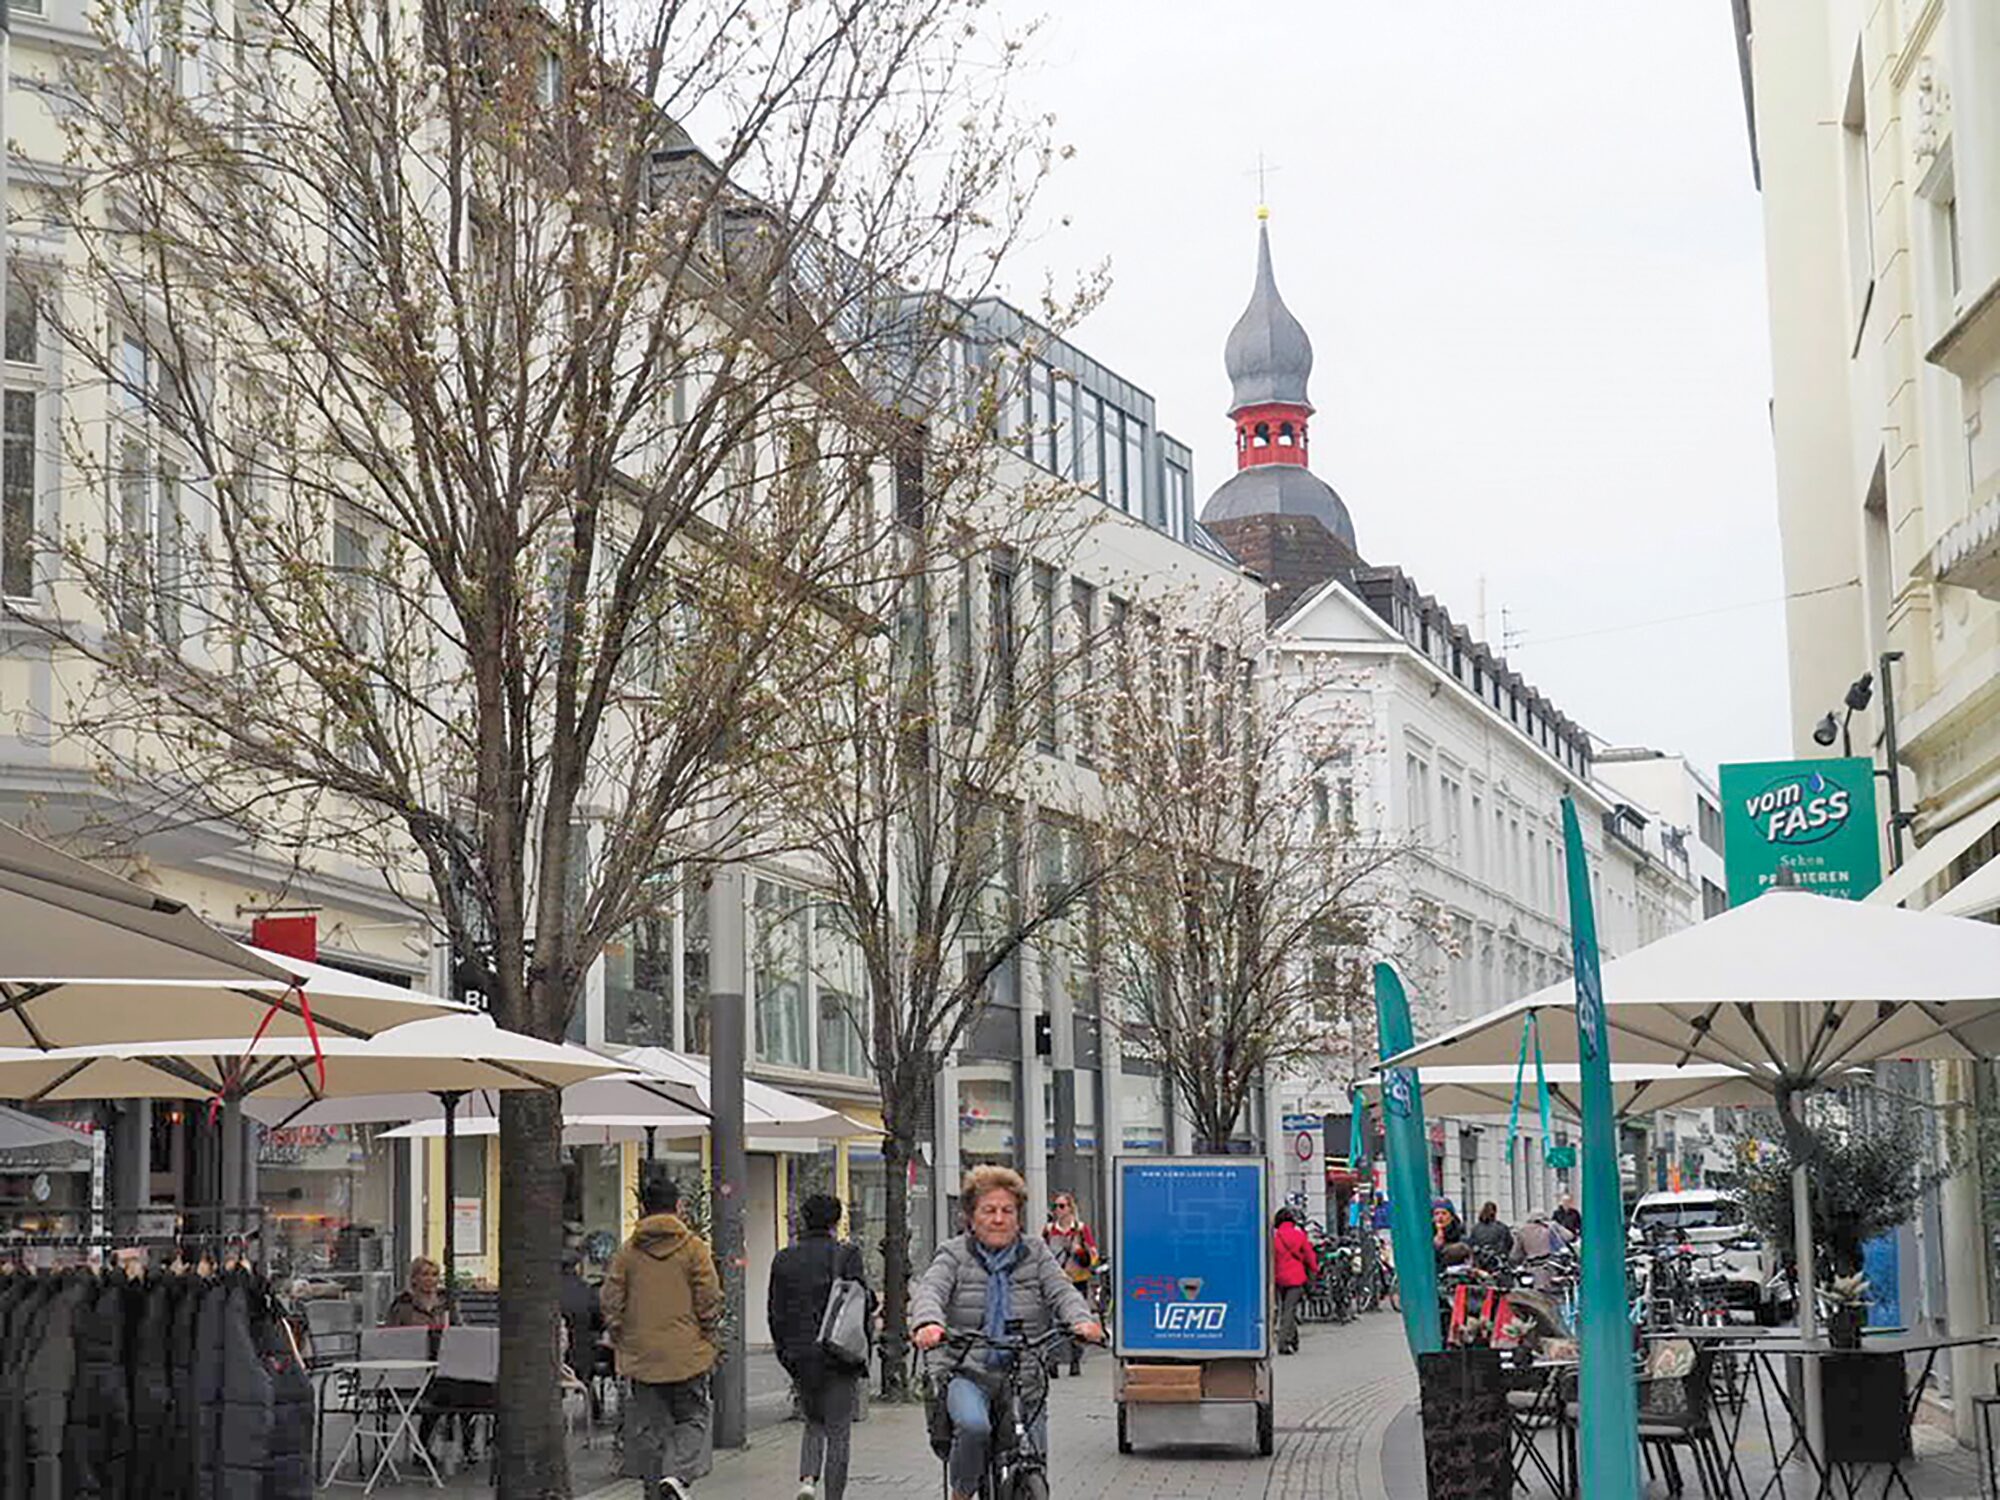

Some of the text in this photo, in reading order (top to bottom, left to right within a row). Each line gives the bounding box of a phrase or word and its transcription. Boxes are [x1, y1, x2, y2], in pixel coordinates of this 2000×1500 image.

[1746, 783, 1800, 816] vom
[1767, 791, 1849, 840] FASS
[1758, 870, 1849, 885] PRBIEREN
[1155, 1302, 1228, 1330] VEMO
